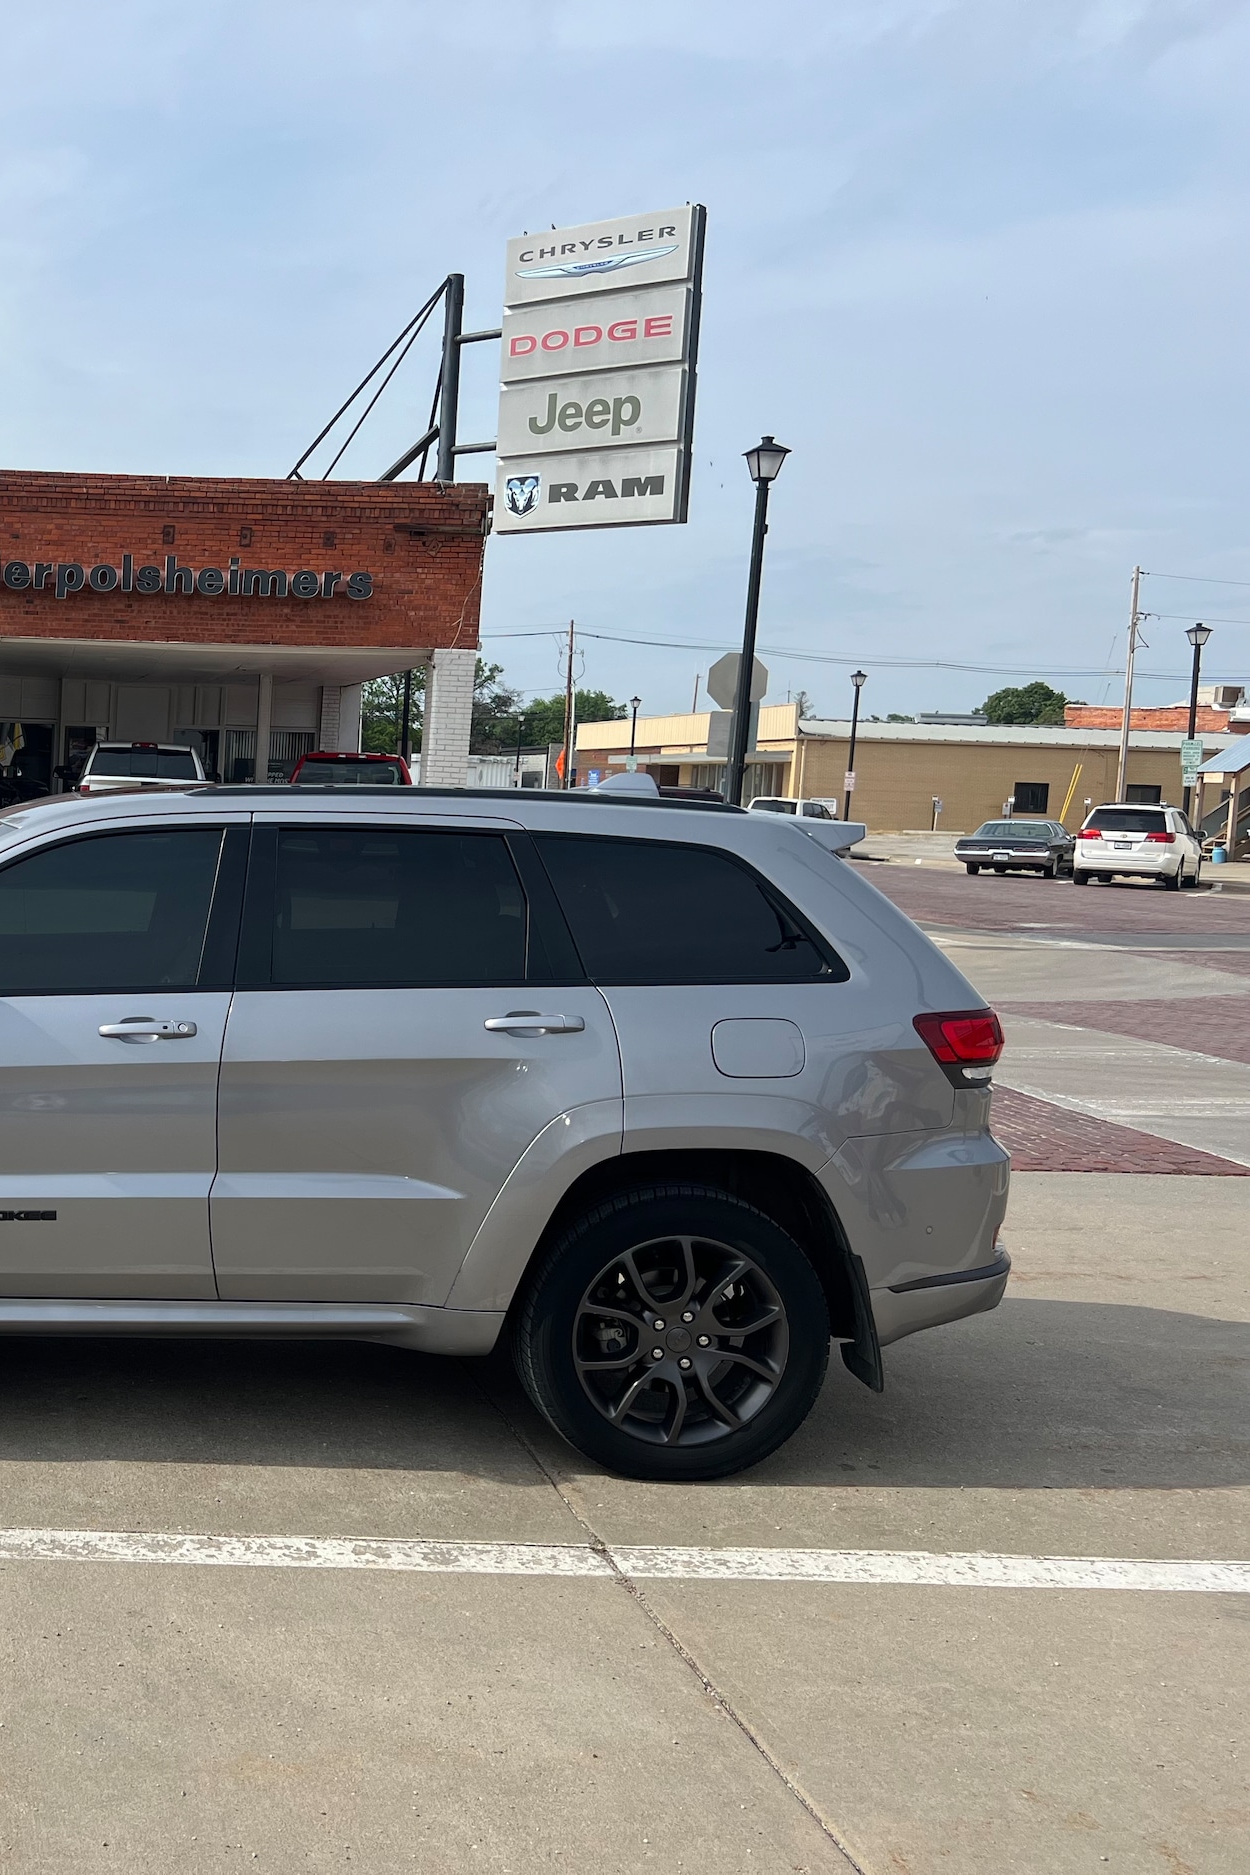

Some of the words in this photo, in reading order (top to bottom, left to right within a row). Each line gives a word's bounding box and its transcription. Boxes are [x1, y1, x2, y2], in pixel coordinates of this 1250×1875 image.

[519, 225, 677, 262] CHRYSLER
[510, 315, 673, 356] DODGE
[528, 393, 641, 436] Jeep
[548, 475, 665, 503] RAM
